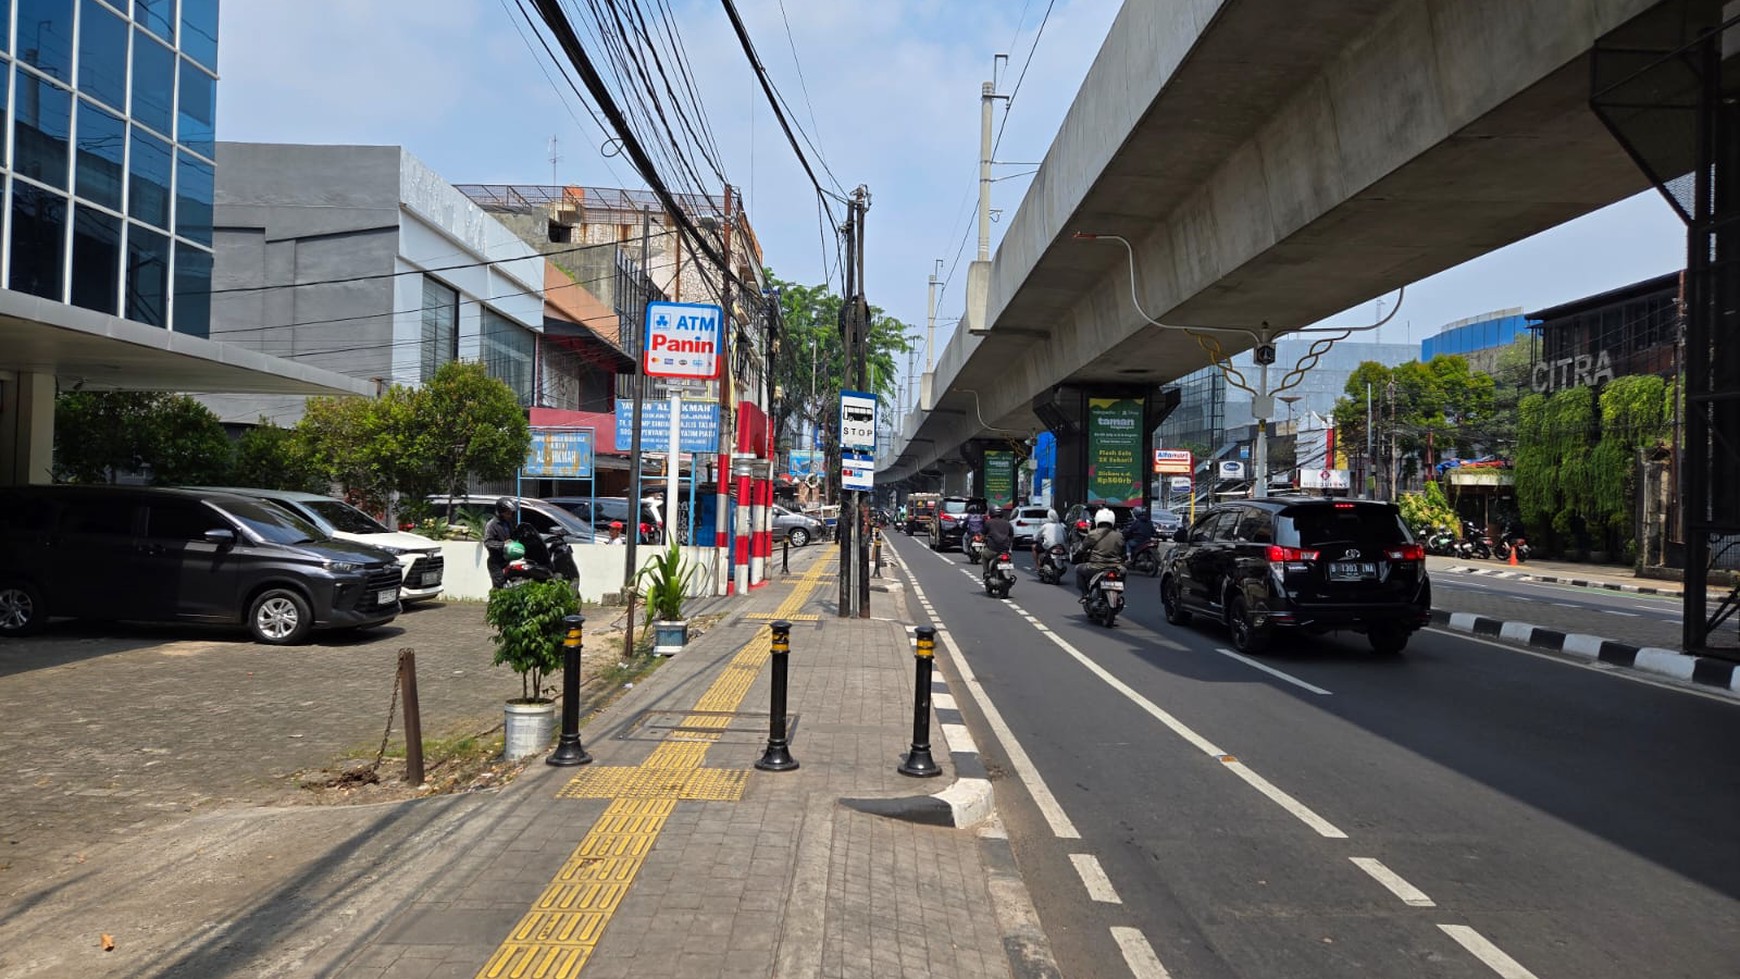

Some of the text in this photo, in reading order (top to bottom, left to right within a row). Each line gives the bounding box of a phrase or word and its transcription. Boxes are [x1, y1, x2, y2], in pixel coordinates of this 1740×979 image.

[676, 315, 715, 331] ATM
[651, 334, 714, 353] Panin
[1532, 349, 1614, 393] CITRA
[1098, 416, 1135, 426] taman
[843, 427, 873, 437] STOP
